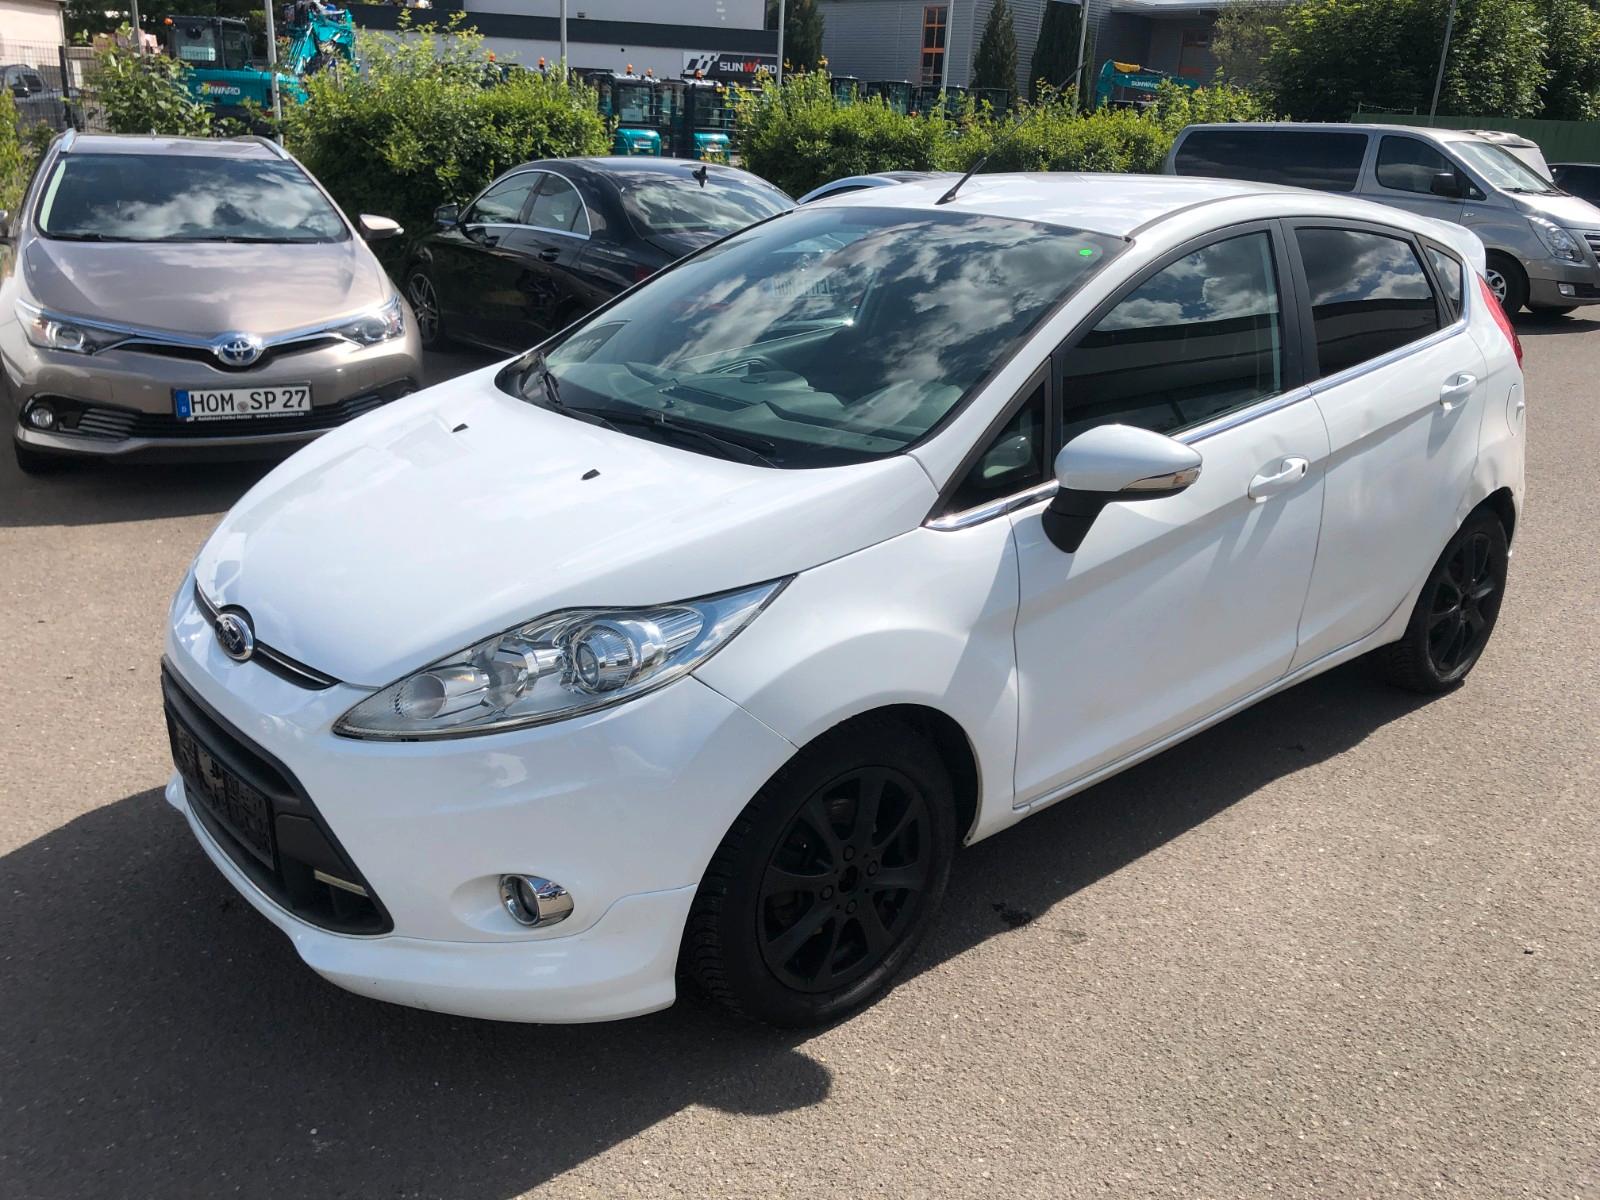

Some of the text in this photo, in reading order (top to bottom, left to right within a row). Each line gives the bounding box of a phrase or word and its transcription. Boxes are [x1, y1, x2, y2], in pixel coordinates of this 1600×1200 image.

[190, 389, 307, 413] HOM SP 27
